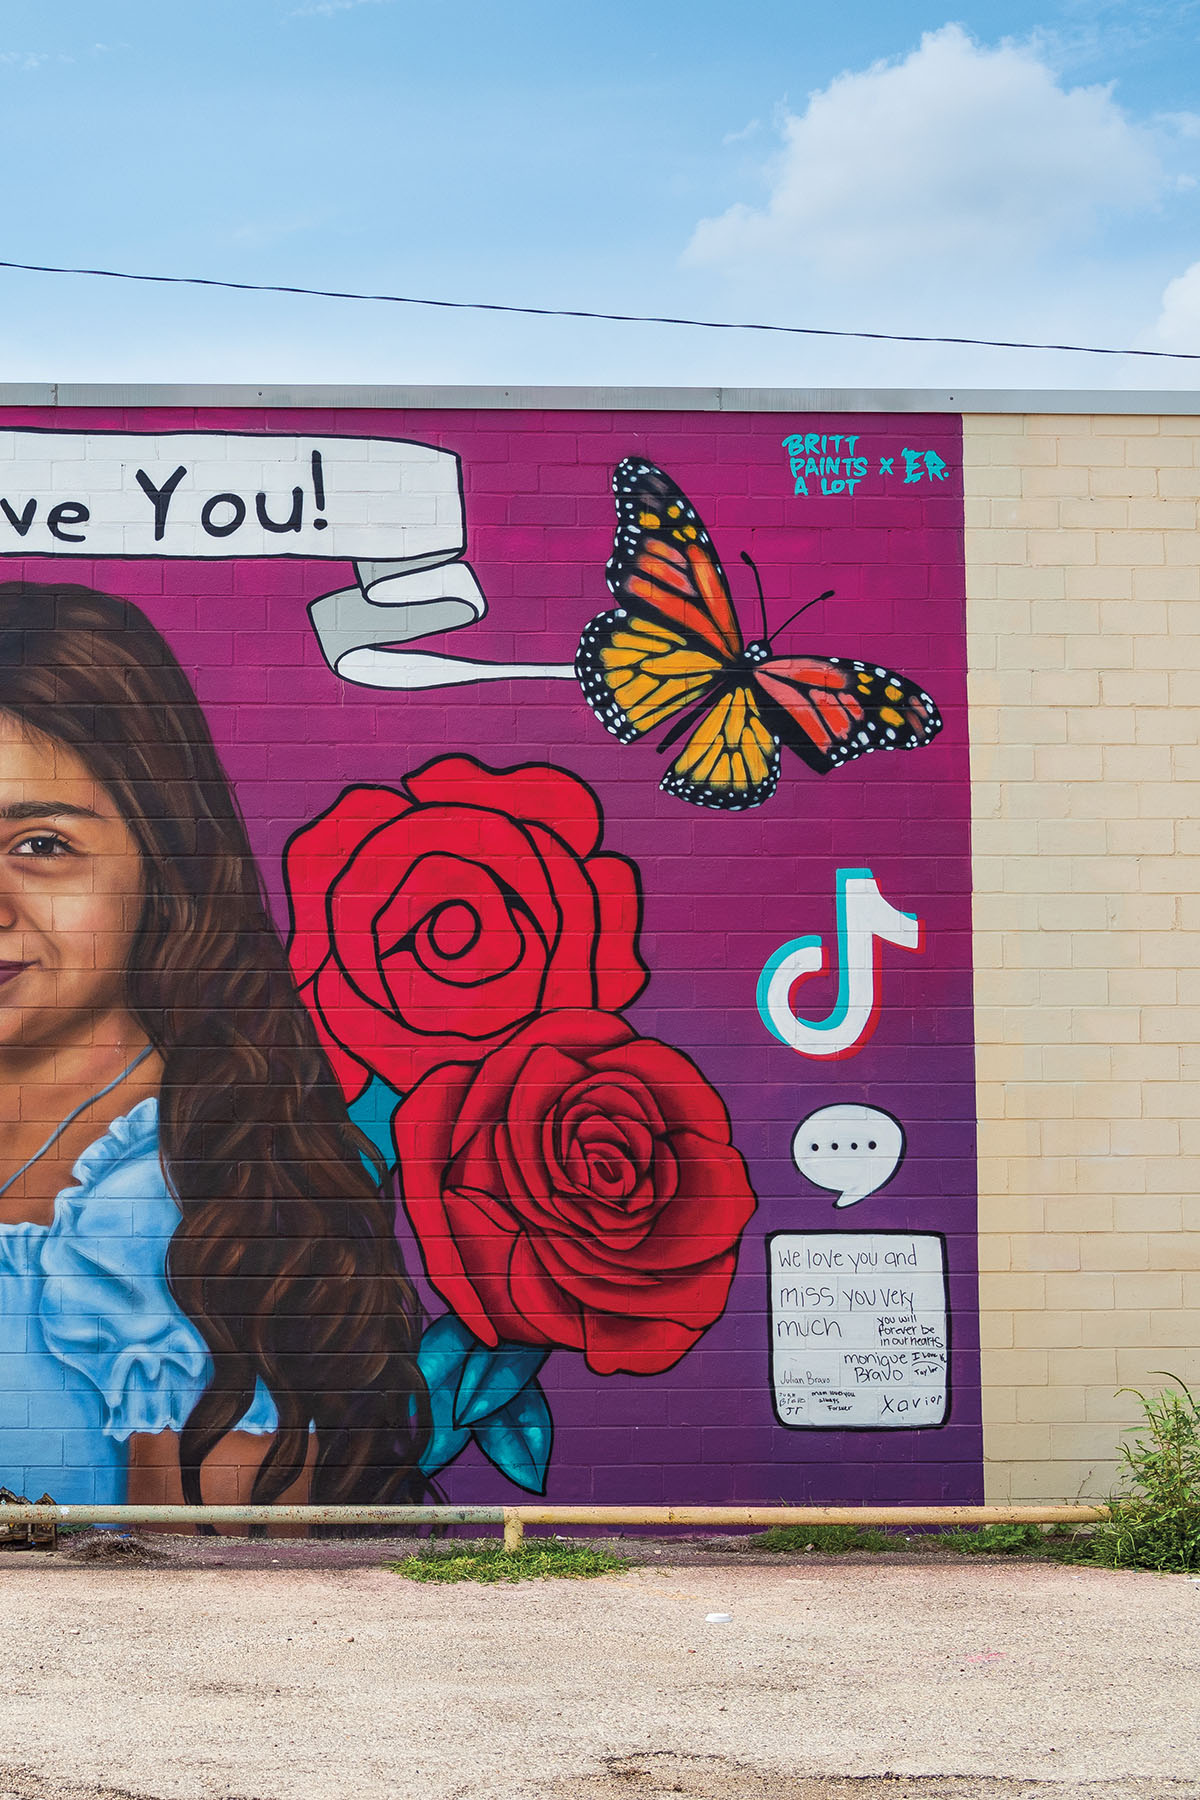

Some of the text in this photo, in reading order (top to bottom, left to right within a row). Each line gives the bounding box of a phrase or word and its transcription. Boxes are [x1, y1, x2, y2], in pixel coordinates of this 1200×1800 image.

[781, 433, 860, 457] BRITT
[789, 456, 869, 478] PAINTS
[135, 450, 327, 541] You!
[794, 476, 862, 496] A LOT
[778, 1243, 918, 1274] We love you and
[780, 1286, 835, 1308] miss
[842, 1288, 876, 1312] you
[777, 1318, 842, 1338] much
[877, 1314, 917, 1327] you will
[878, 1323, 935, 1337] forever be
[880, 1335, 944, 1349] in our hearts
[911, 1352, 921, 1361] I
[780, 1370, 831, 1385] Julian Bravo
[854, 1366, 904, 1384] Bravo
[880, 1395, 943, 1415] Xavier
